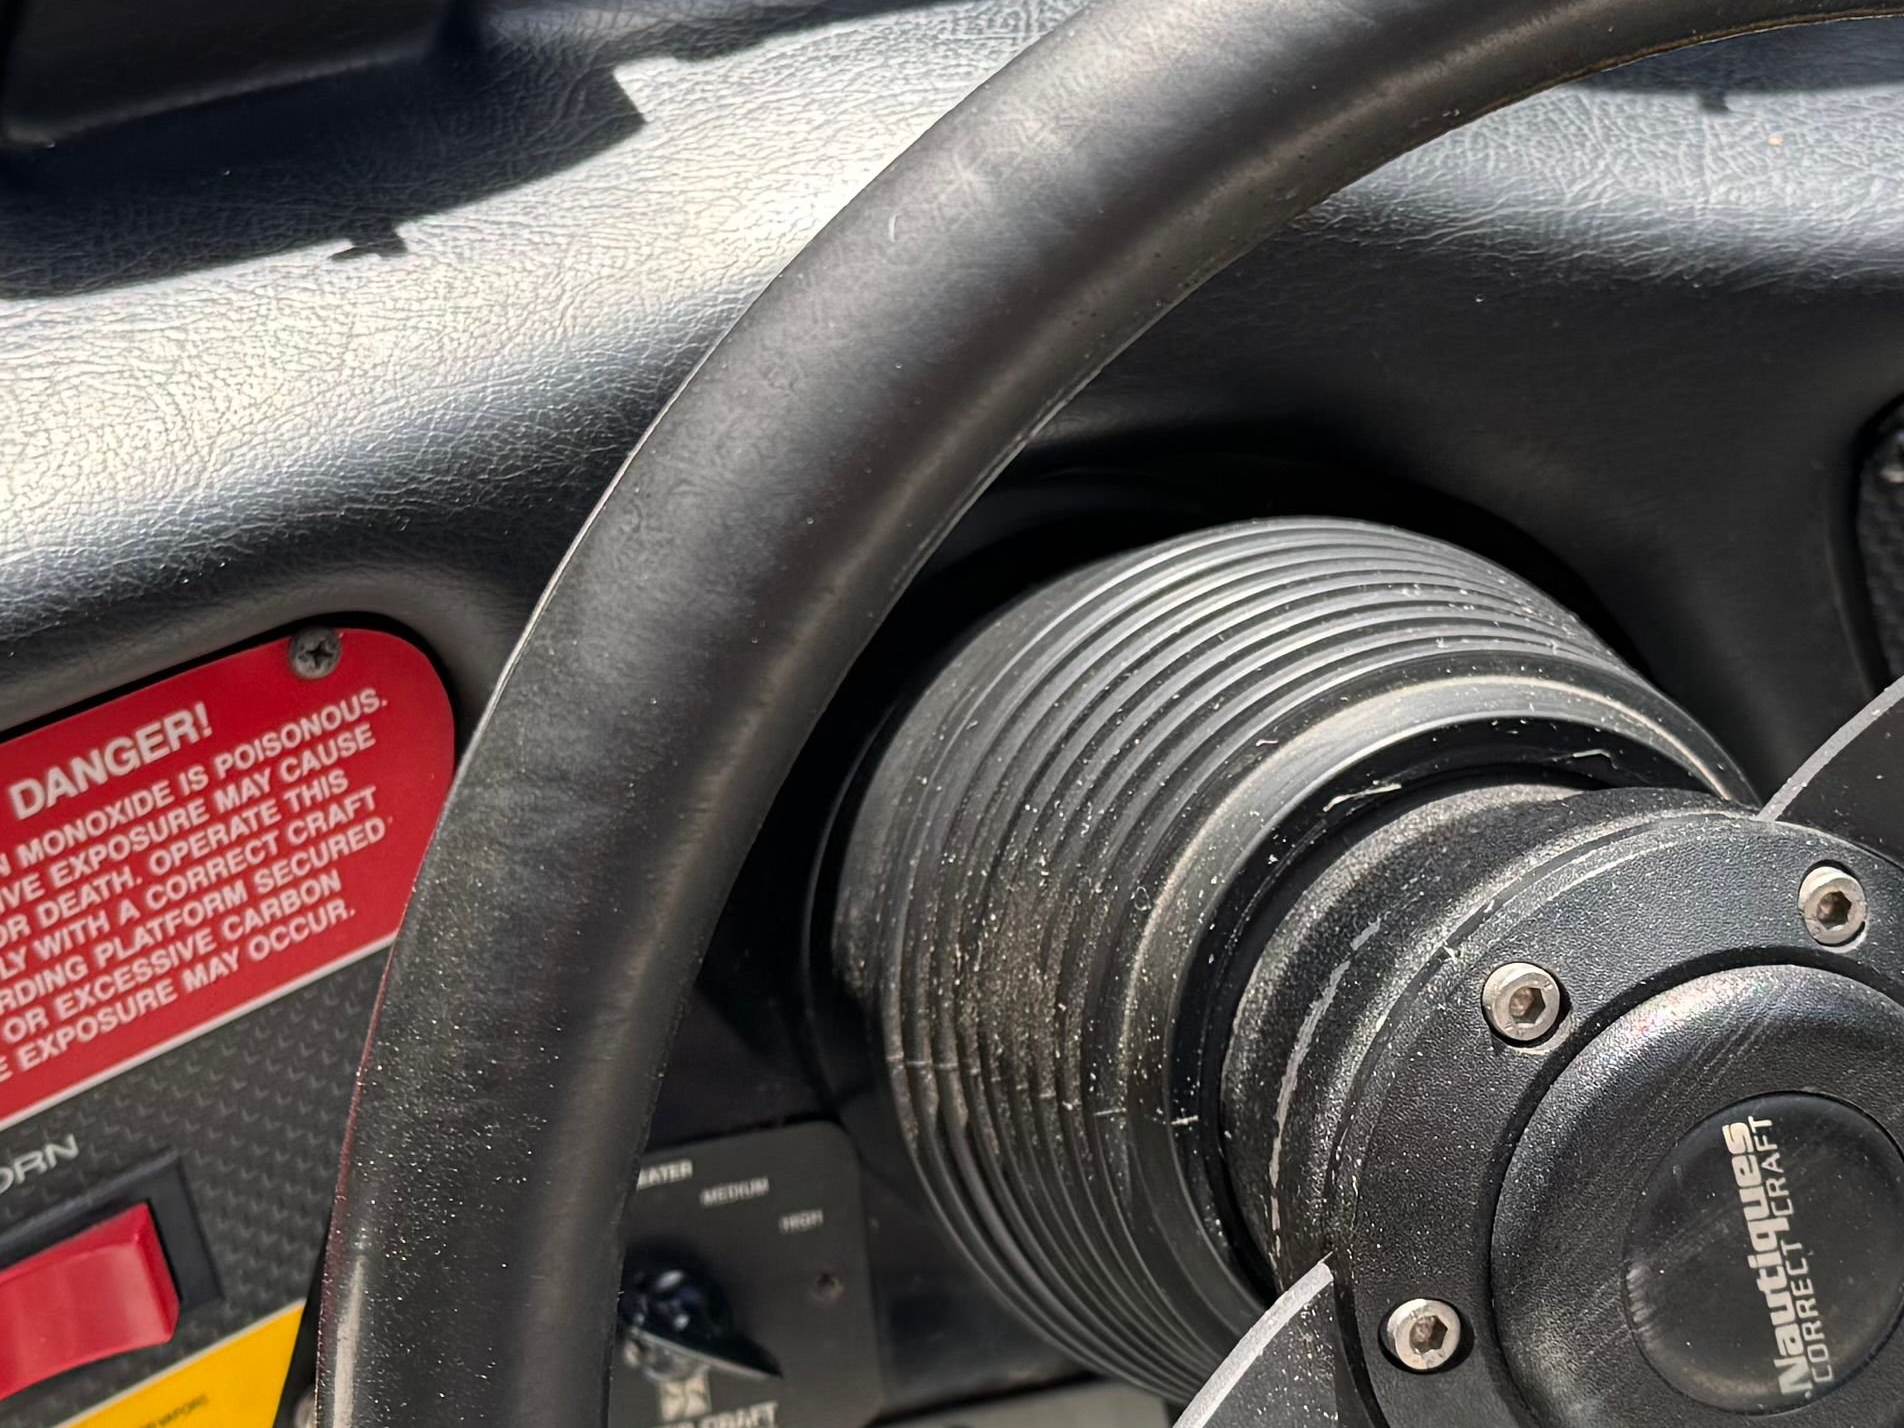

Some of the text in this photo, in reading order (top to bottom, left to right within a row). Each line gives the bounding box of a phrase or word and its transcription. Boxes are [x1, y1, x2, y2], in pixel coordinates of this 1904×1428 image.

[7, 702, 212, 820] DANGER!
[15, 779, 175, 868] MONOXIDE
[177, 764, 209, 796] IS
[213, 687, 387, 779] POISONOUS.
[35, 864, 142, 928] DEATH.
[147, 798, 282, 876] OPERATE
[282, 768, 349, 813] THIS
[47, 797, 210, 888] EXPOSURE
[212, 766, 271, 813] MAY
[278, 722, 375, 783] CAUSE
[0, 1005, 49, 1043] OR
[52, 926, 217, 1021] EXCESSIVE
[220, 868, 342, 941] CARBON
[31, 908, 110, 961] WITH
[117, 898, 141, 925] A
[144, 829, 279, 910] CORRECT
[285, 785, 376, 845] CRAFT
[92, 878, 248, 969] PLATFORM
[252, 816, 385, 894] SECURED
[14, 977, 178, 1071] EXPOSURE
[180, 945, 239, 993] MAY
[246, 897, 356, 961] OCCUR.
[1722, 1121, 1814, 1397] Nautiques
[1748, 1116, 1834, 1383] CORRECT CRAFT
